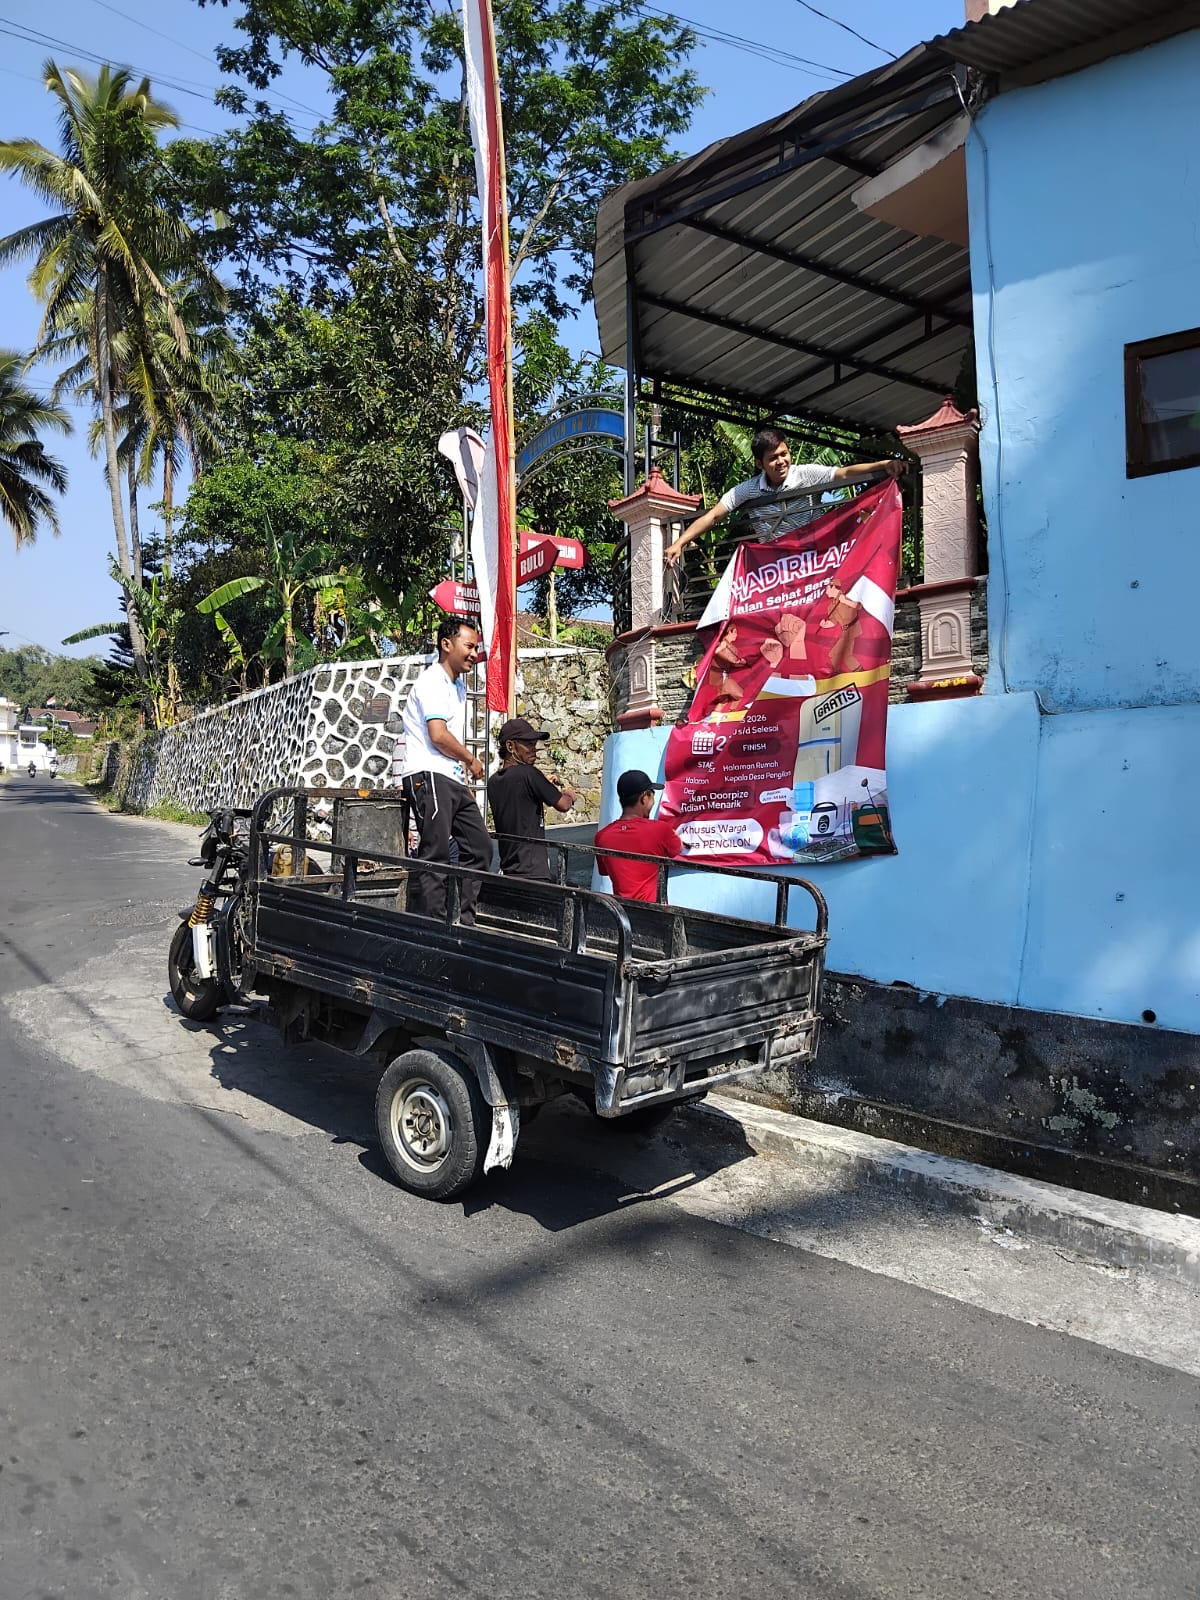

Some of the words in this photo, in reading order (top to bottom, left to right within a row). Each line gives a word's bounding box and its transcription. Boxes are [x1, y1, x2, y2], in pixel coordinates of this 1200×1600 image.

[520, 550, 544, 576] BULU
[766, 588, 801, 606] Sehat
[783, 588, 825, 609] Pengil
[453, 599, 480, 612] WONO
[817, 689, 856, 718] GRATIS
[746, 714, 767, 724] 2026
[752, 725, 779, 735] Selesai
[742, 743, 767, 752] FINISH
[723, 763, 755, 771] Halaman
[756, 761, 779, 769] Rumah
[724, 773, 749, 783] Kepala
[749, 772, 765, 780] Desa
[766, 770, 791, 780] Pengilon
[709, 790, 749, 801] Doorpize
[707, 800, 742, 810] Menarik
[682, 825, 716, 834] Khusus
[717, 824, 747, 834] Warga
[703, 838, 751, 849] PENGILON
